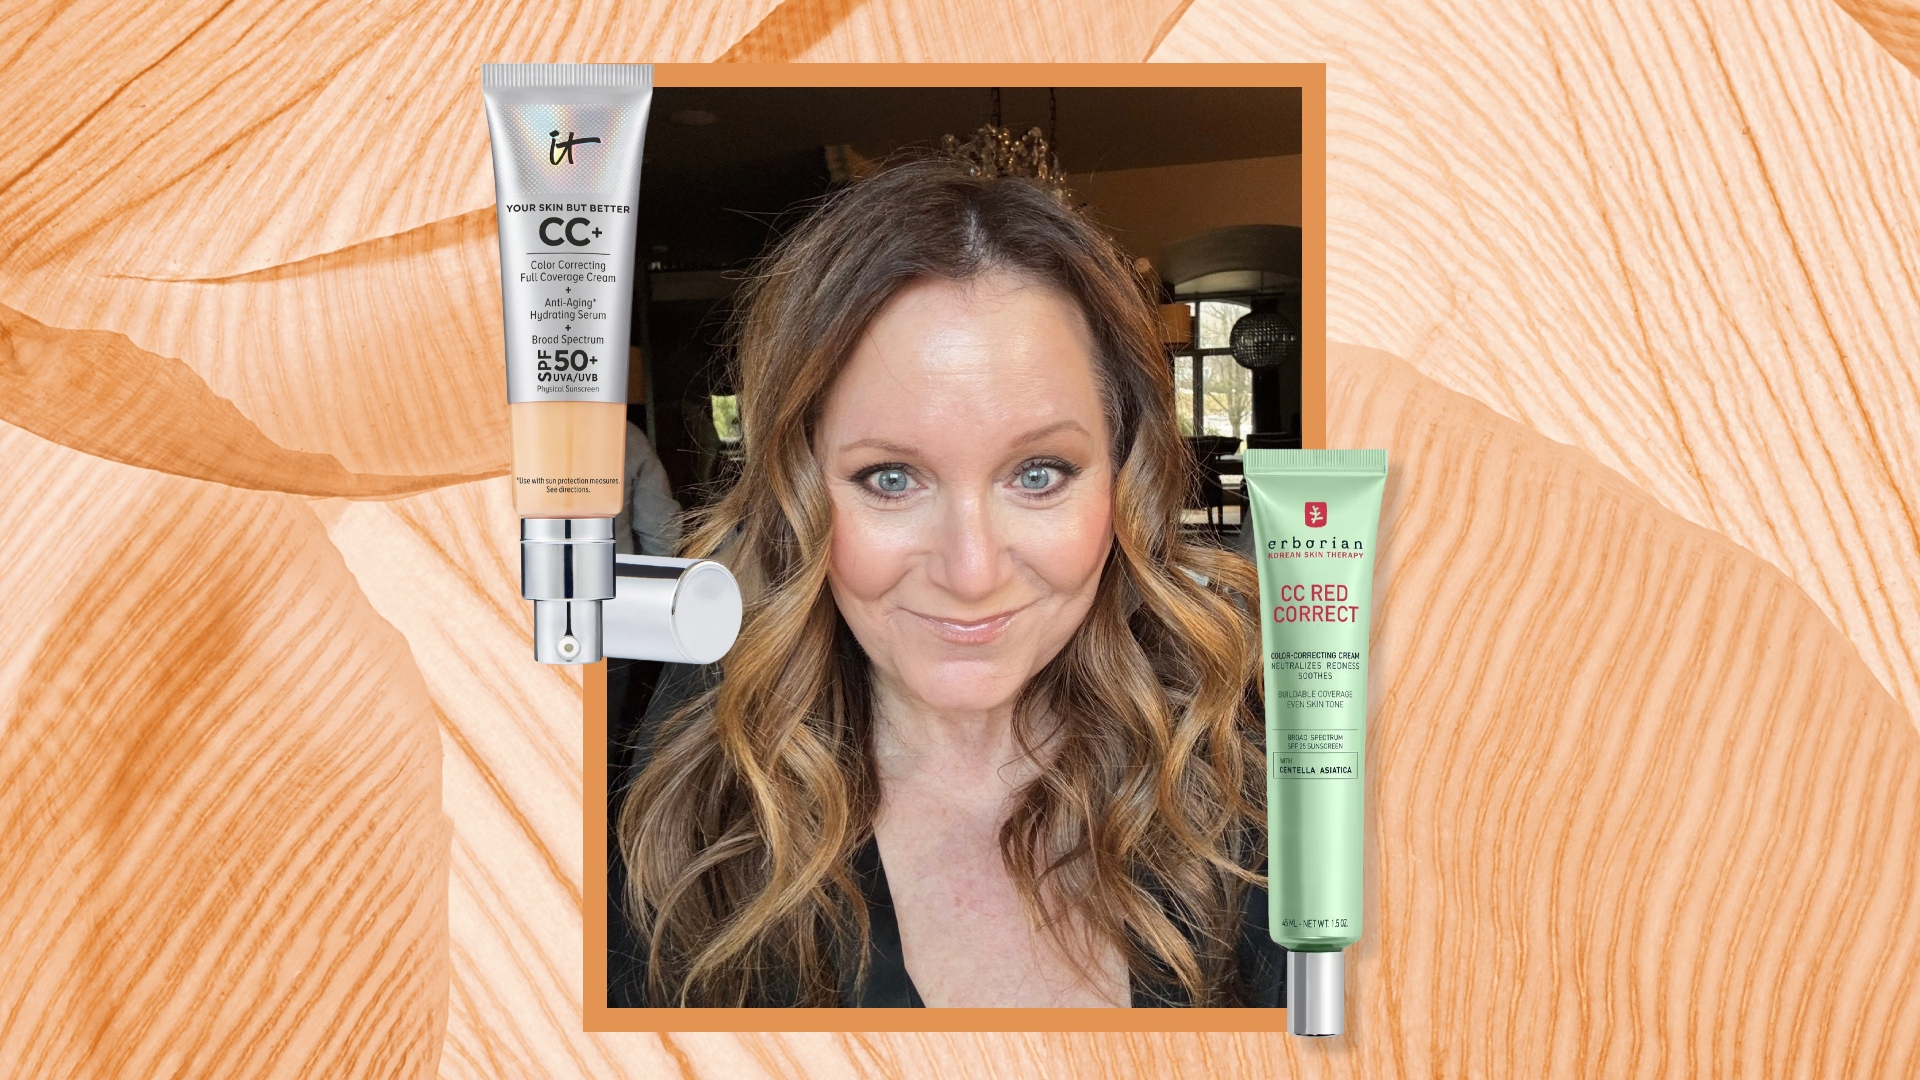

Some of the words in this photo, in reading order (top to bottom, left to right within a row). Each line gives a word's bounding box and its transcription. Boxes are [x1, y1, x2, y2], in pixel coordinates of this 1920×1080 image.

[549, 130, 601, 165] it
[506, 204, 536, 213] YOUR
[539, 204, 564, 212] SKIN
[566, 204, 587, 212] BUT
[589, 204, 630, 214] BETTER
[538, 216, 602, 246] CC+
[530, 260, 556, 270] Color
[558, 260, 606, 272] Correcting
[520, 272, 538, 282] Full
[540, 272, 584, 283] Coverage
[586, 272, 616, 282] Cream
[530, 310, 575, 321] Hydrating
[578, 310, 606, 320] Serum
[532, 335, 558, 344] Broad
[561, 335, 604, 345] Spectrum
[538, 350, 552, 382] SPF
[554, 350, 598, 372] 50+
[553, 373, 598, 382] UVA/UVB
[537, 385, 564, 394] Physical
[566, 385, 600, 393] Sunscreen
[558, 477, 588, 485] protection
[1268, 536, 1364, 550] erborian
[1281, 584, 1305, 602] CC
[1311, 584, 1348, 602] RED
[1274, 605, 1359, 623] CORRECT
[1270, 652, 1336, 660] COLOR-CORRECTING
[1272, 662, 1322, 670] NEUTRALIZES
[1298, 672, 1332, 680] SOOTHES
[1278, 690, 1316, 698] BUILDABLE
[1318, 690, 1352, 698] COVERAGE
[1303, 920, 1316, 928] NET
